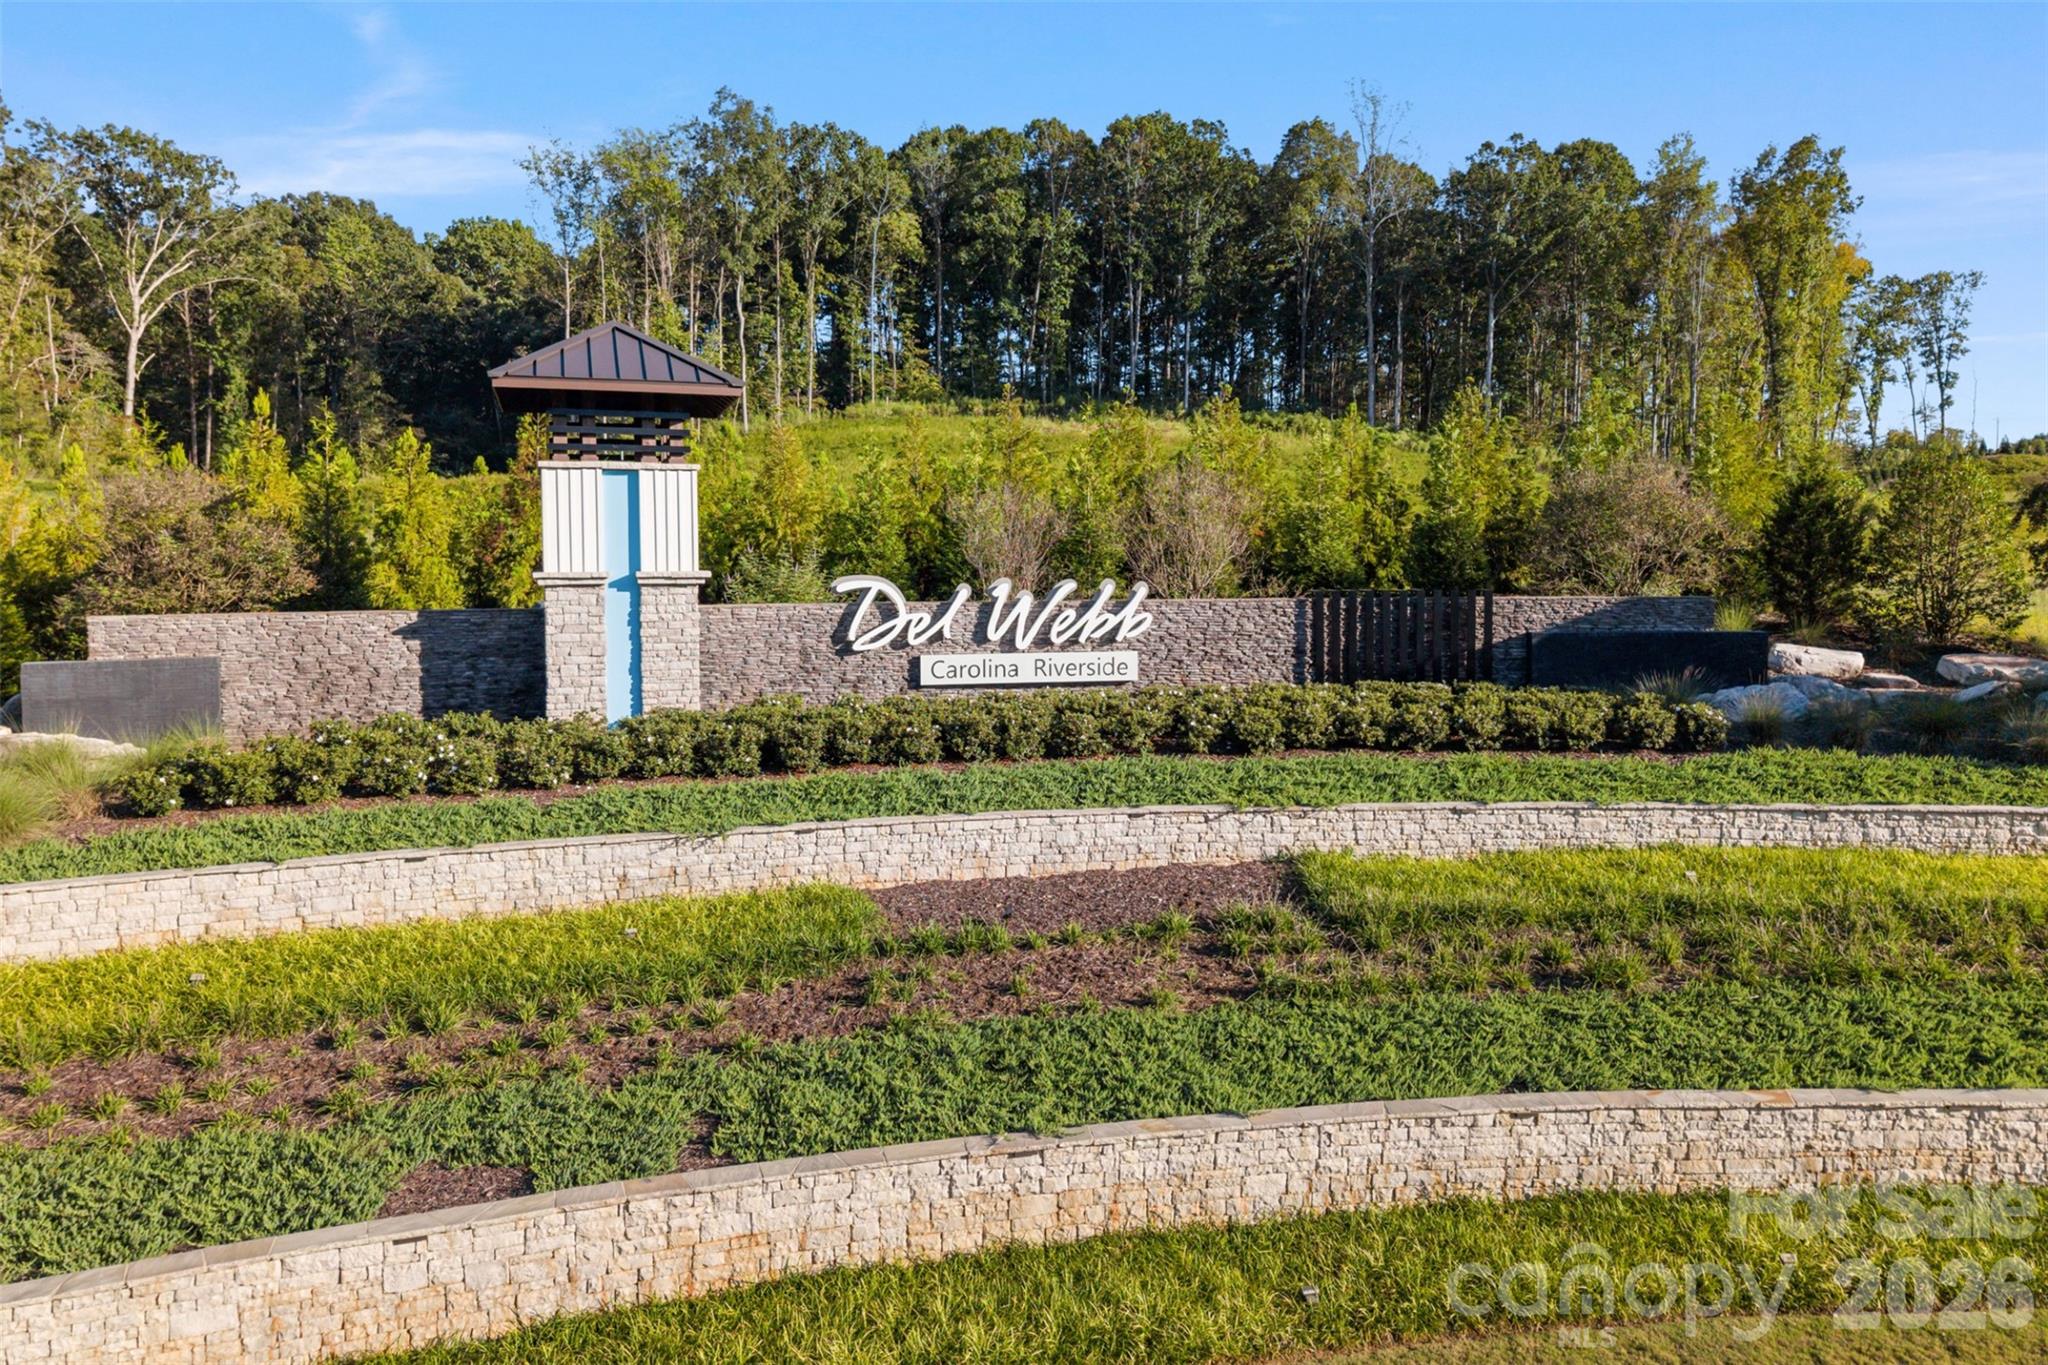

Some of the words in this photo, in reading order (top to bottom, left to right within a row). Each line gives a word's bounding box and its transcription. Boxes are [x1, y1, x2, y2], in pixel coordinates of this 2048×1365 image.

[831, 575, 972, 651] Del
[985, 577, 1152, 650] Webb
[930, 659, 1019, 679] Carolina
[1034, 657, 1128, 677] Riverside
